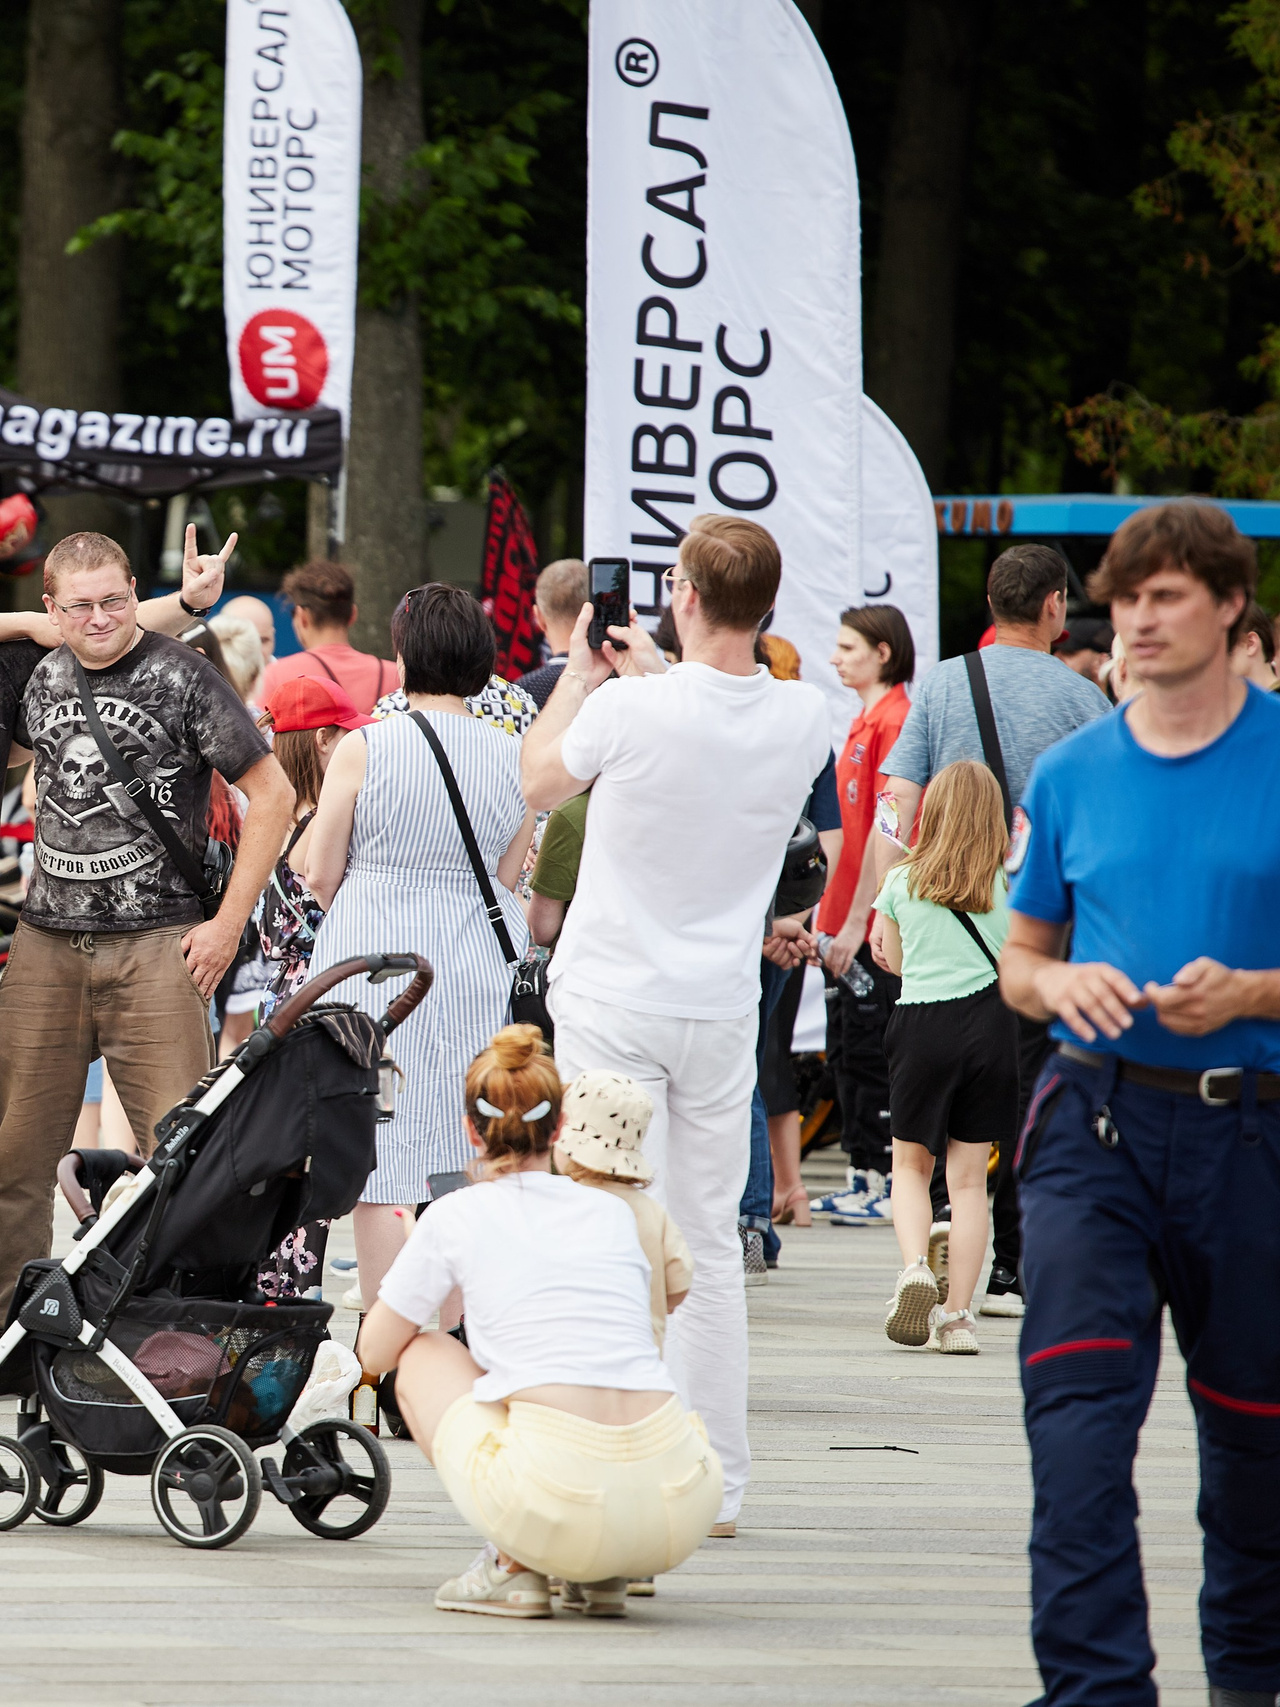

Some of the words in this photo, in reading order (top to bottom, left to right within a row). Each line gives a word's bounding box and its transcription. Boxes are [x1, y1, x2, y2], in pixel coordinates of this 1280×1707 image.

[246, 10, 289, 290] ЮНИВЕРСАЛ
[282, 107, 318, 290] МОТОРС
[259, 325, 300, 399] UM
[631, 100, 710, 617] НИВЕРСАЛ
[708, 323, 778, 511] ОРС
[112, 1358, 141, 1390] Baballo
